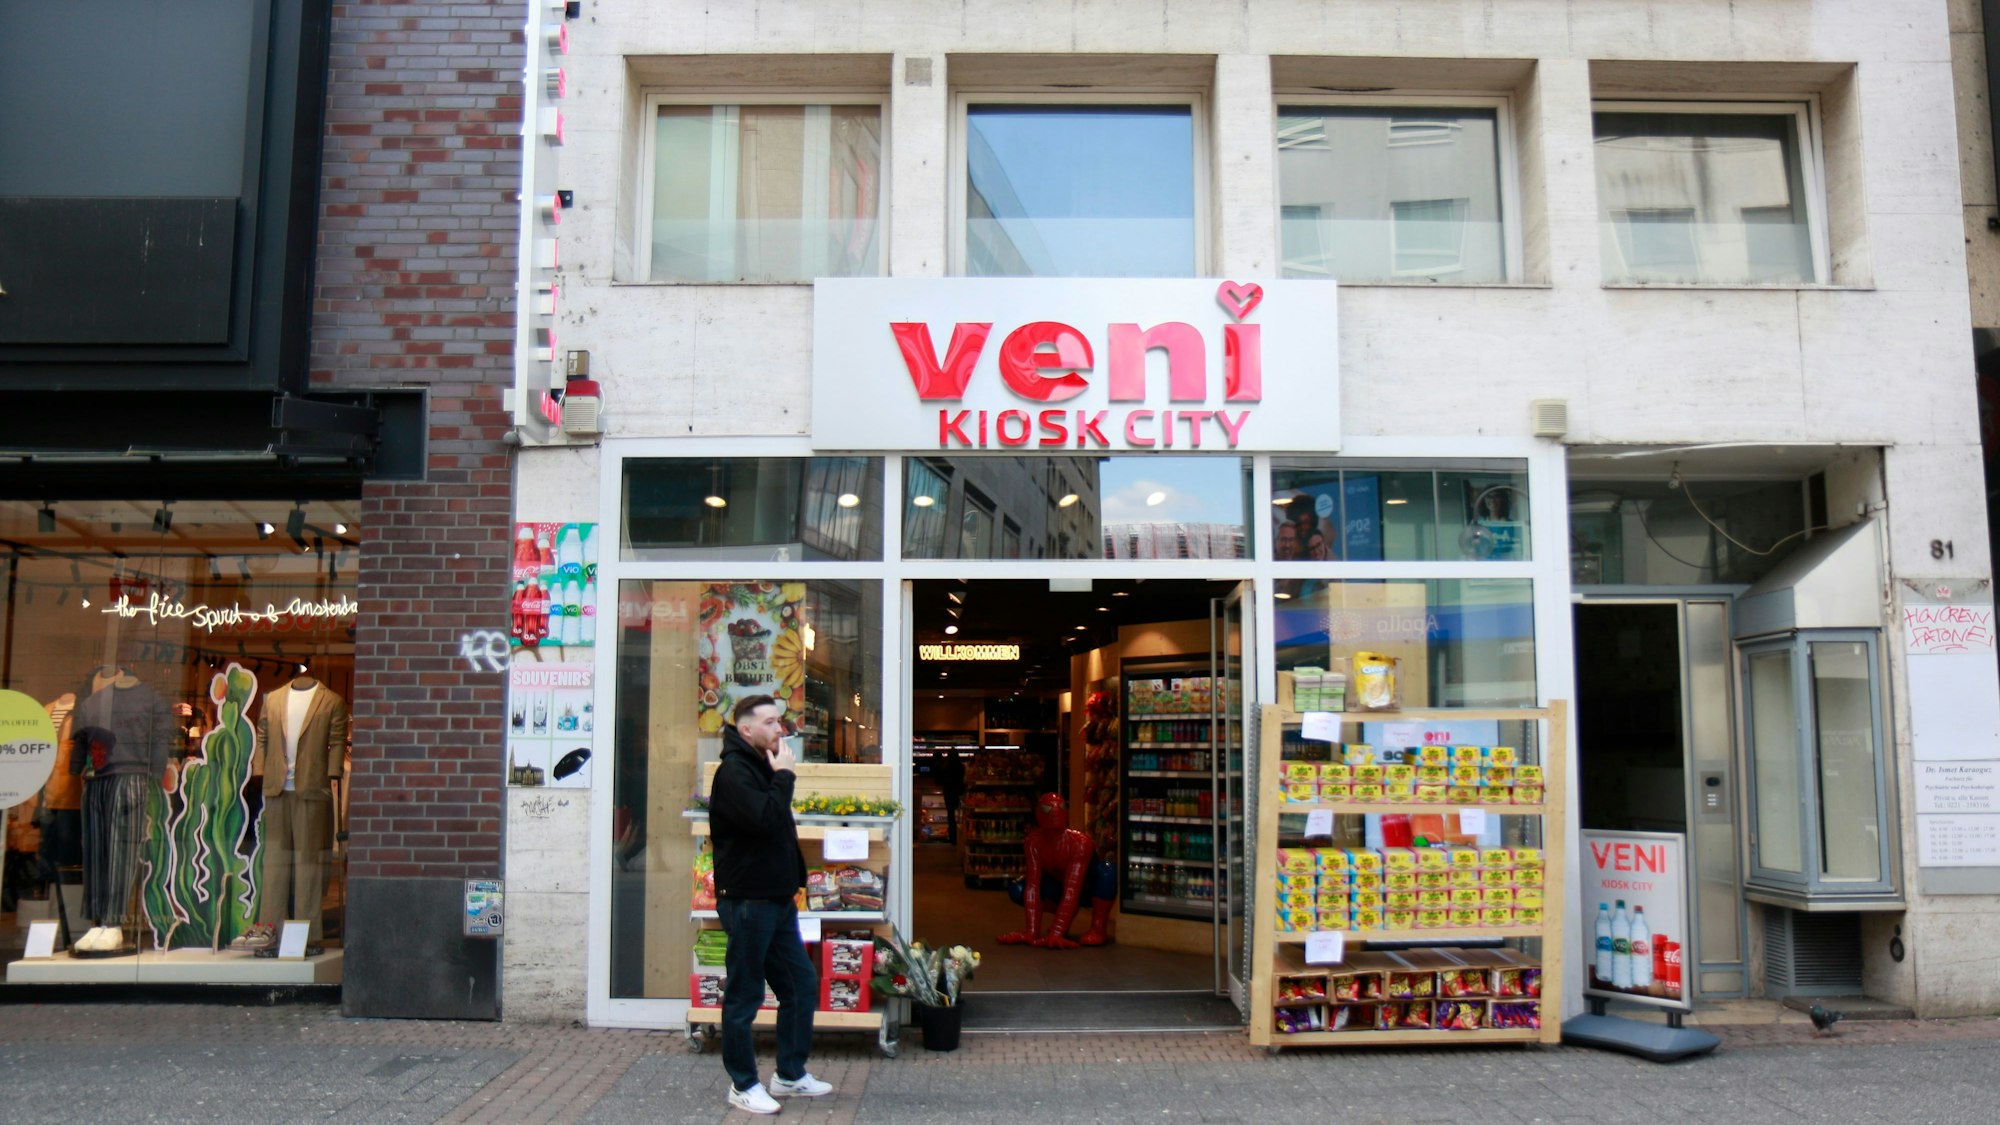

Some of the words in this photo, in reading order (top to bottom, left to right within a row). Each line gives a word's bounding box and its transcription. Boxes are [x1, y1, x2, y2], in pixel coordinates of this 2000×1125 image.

[889, 280, 1262, 402] veni
[938, 408, 1111, 447] KIOSK
[1125, 408, 1251, 447] CITY
[1930, 539, 1955, 561] 81
[919, 644, 1020, 661] WILLKOMMEN
[734, 660, 768, 671] OBST
[512, 669, 591, 687] SOUVENIRS
[11, 719, 39, 727] OFFER
[1590, 840, 1666, 874] VENI
[1601, 879, 1630, 890] KIOSK
[1632, 880, 1654, 892] CITY
